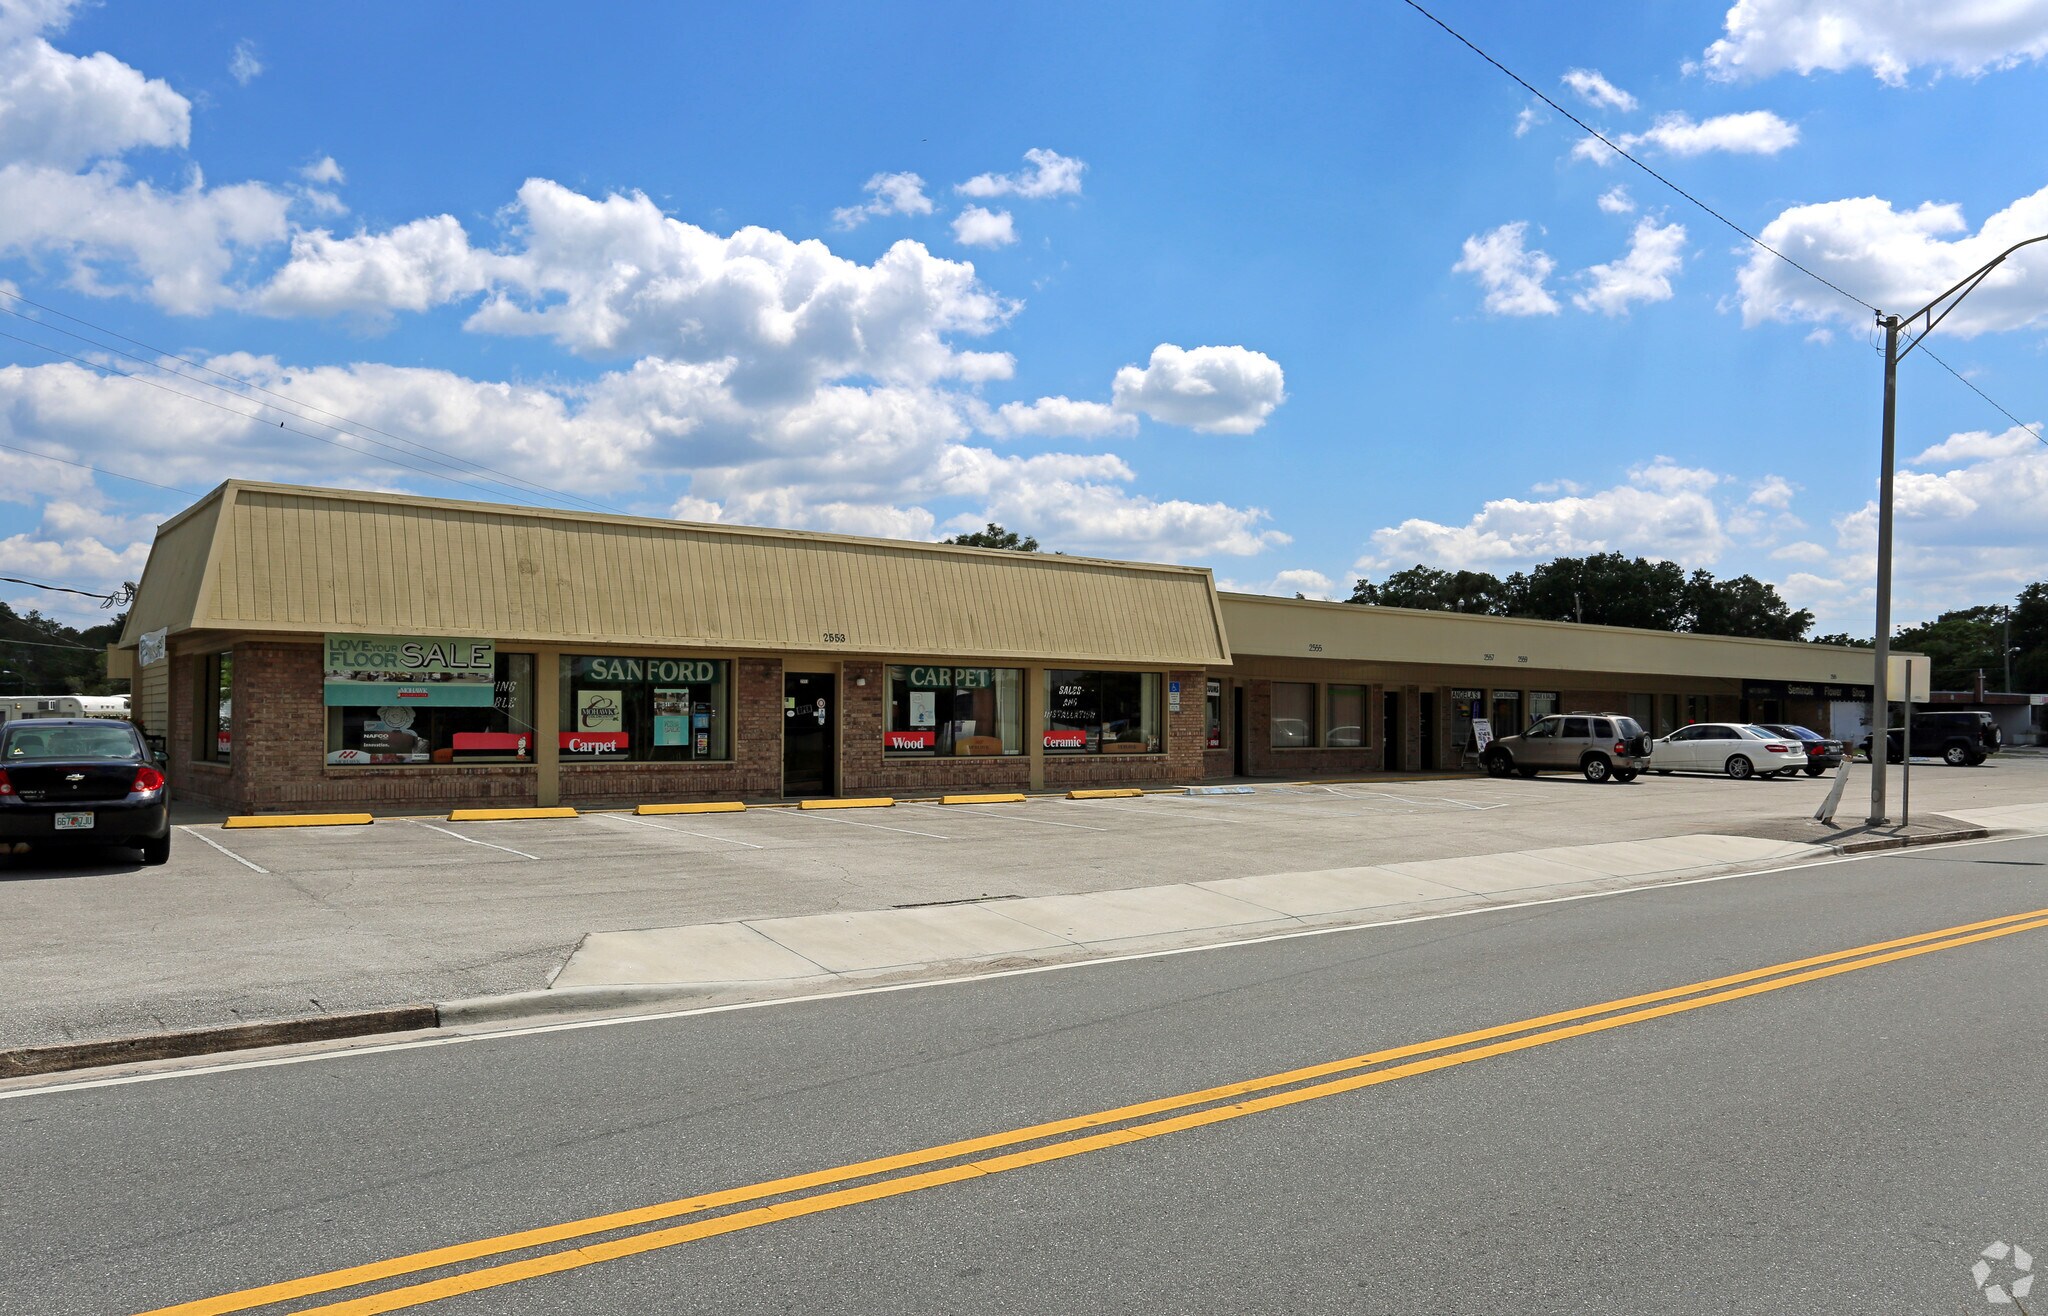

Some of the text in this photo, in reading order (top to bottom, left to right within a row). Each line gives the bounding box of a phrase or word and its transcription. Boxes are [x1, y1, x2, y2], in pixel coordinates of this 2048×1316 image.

[823, 633, 846, 643] 2553
[329, 640, 398, 652] LOVE YOUR
[329, 652, 397, 667] FLOOR
[400, 643, 491, 668] SALE
[591, 658, 714, 682] SANFORD
[910, 667, 989, 687] CARPET
[1788, 685, 1865, 698] Seminole Flower Shop
[569, 738, 616, 756] Carpet
[892, 737, 924, 749] Wood
[1044, 736, 1081, 748] Ceramic
[57, 817, 71, 826] 667
